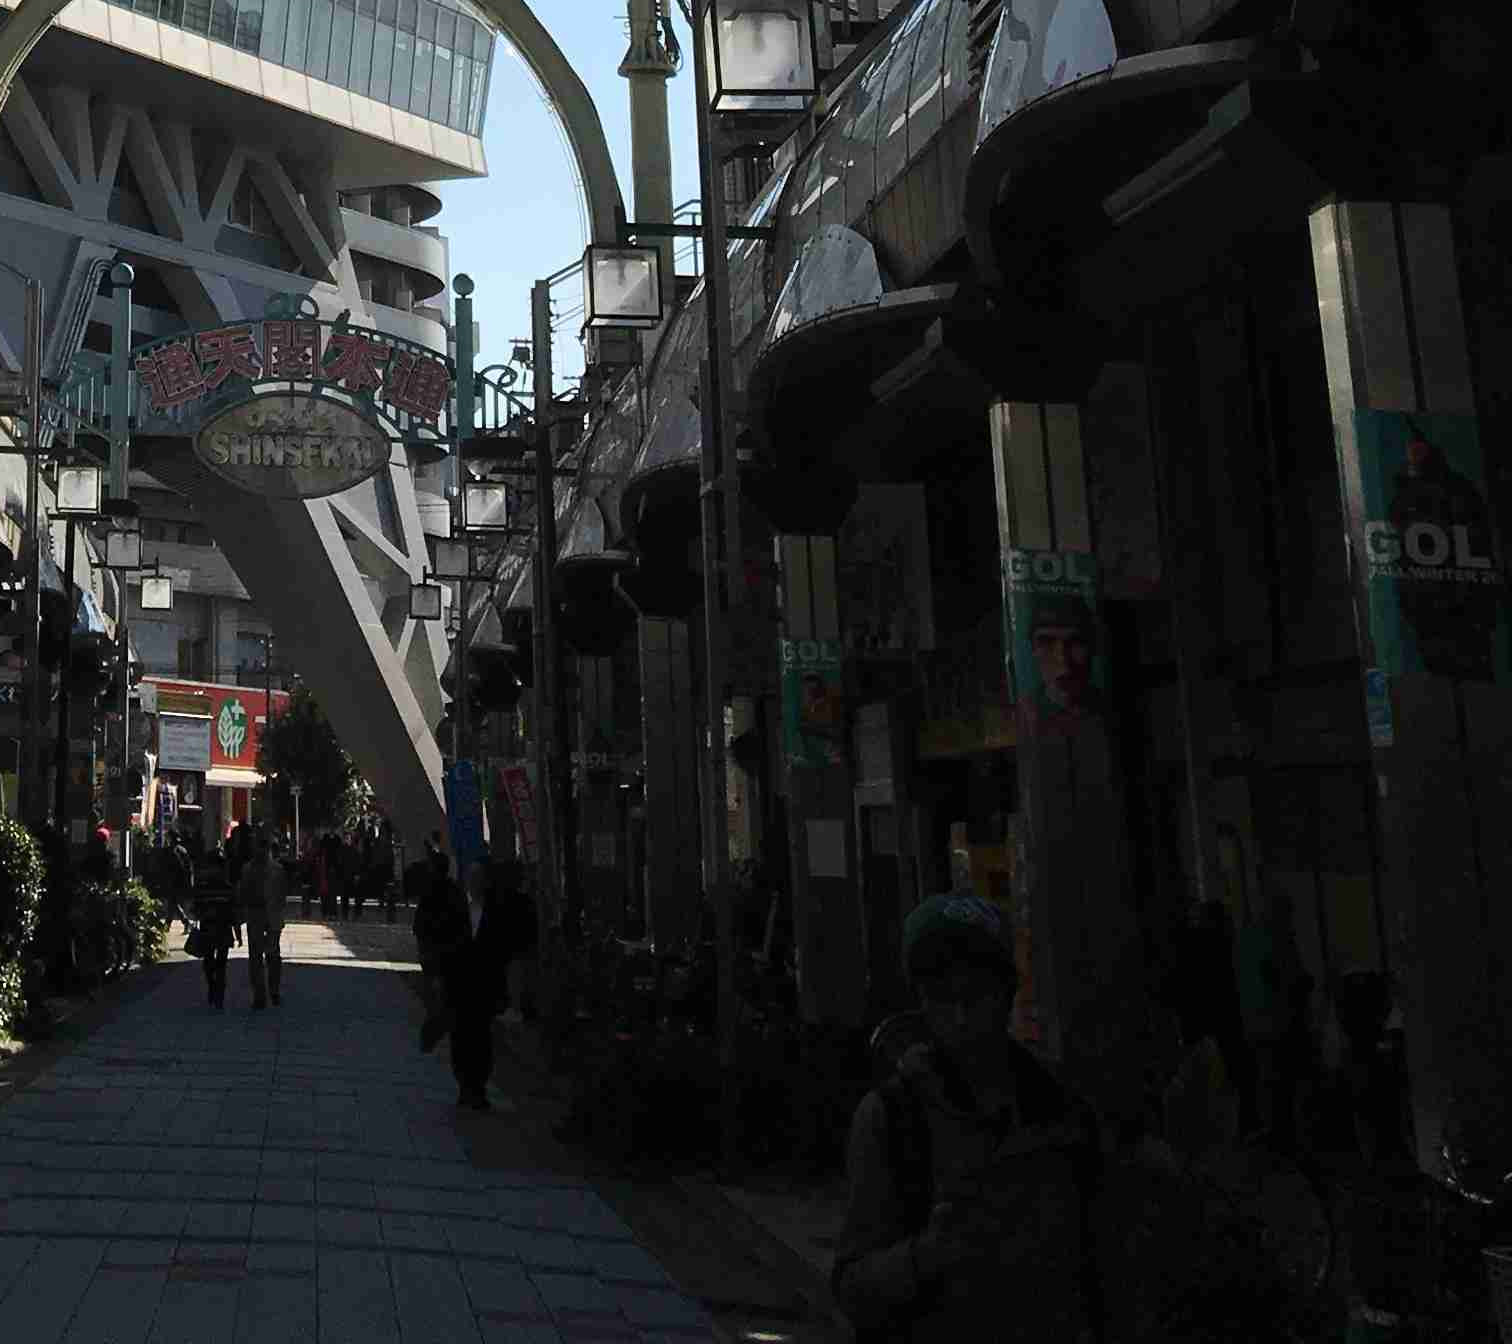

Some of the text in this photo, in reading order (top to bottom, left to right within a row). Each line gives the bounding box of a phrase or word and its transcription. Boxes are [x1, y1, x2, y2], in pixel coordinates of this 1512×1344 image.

[135, 321, 451, 422] 通天閣本通
